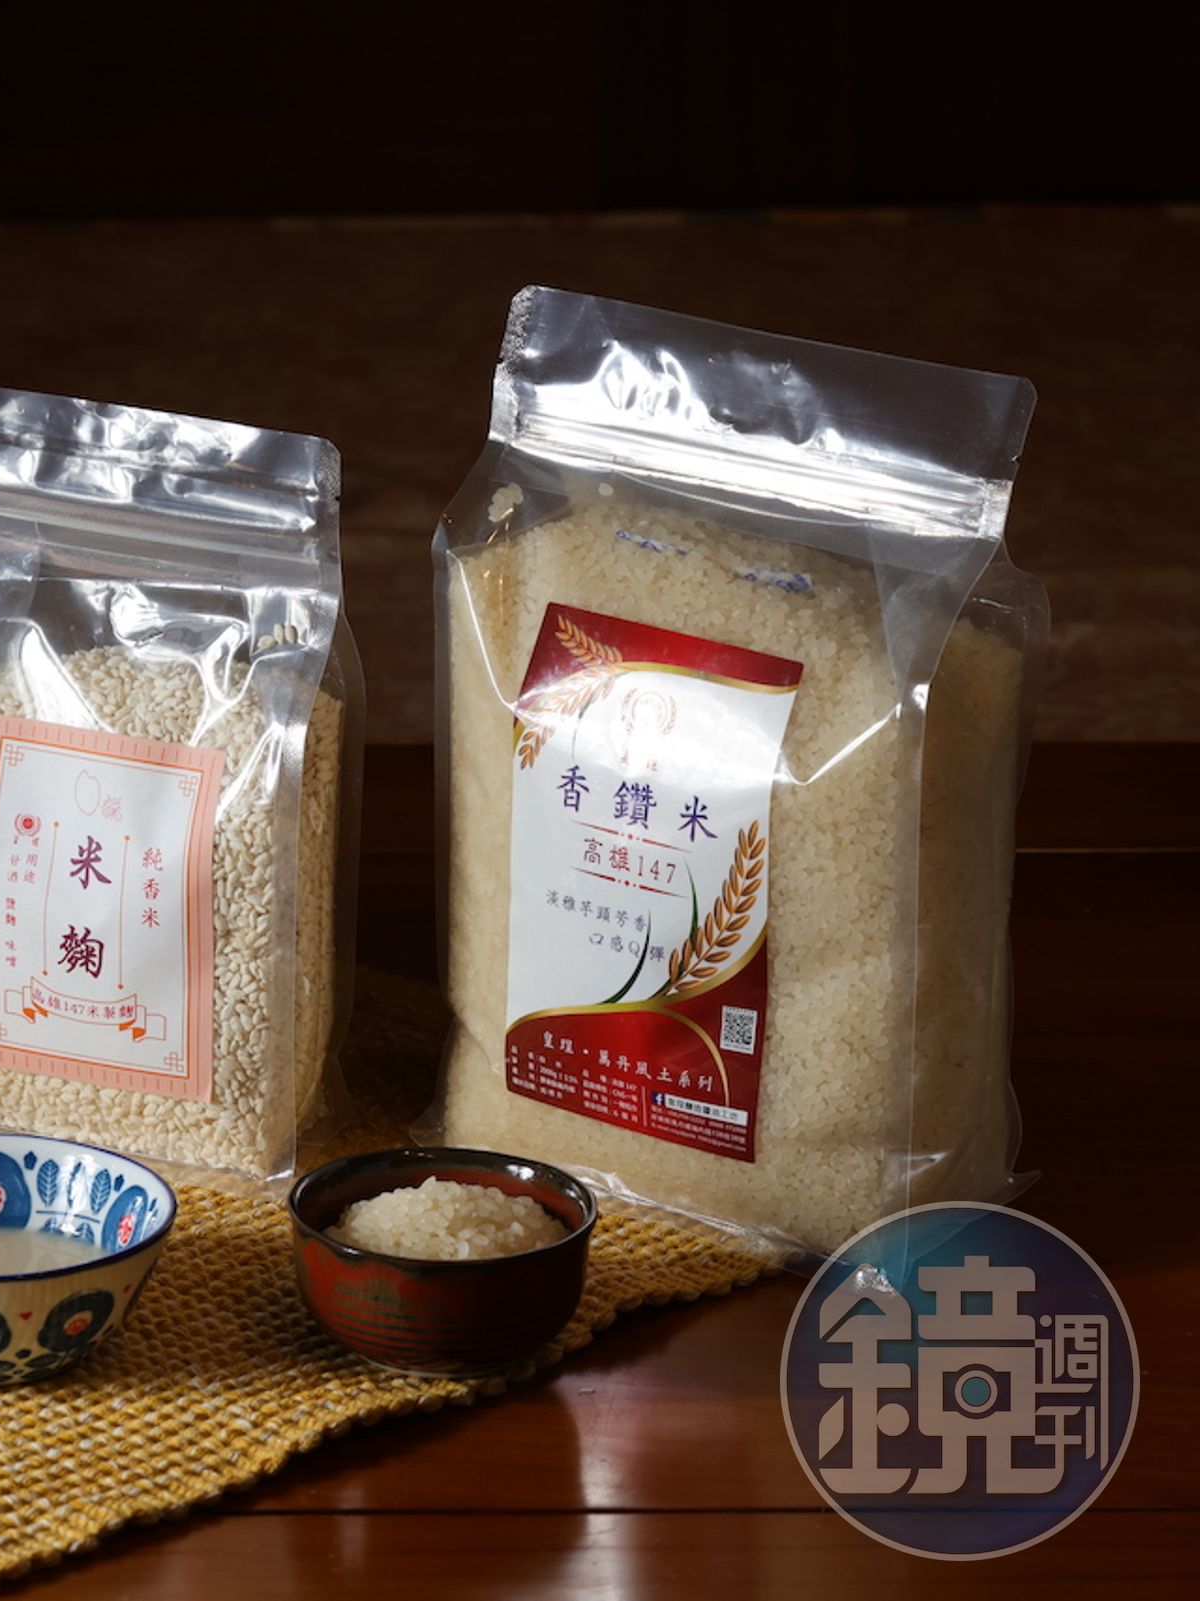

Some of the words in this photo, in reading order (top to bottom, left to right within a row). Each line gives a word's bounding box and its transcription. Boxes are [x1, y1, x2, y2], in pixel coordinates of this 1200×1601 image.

[556, 765, 718, 842] 香鑽米
[142, 847, 164, 928] 純香米
[583, 837, 677, 884] 高雄147
